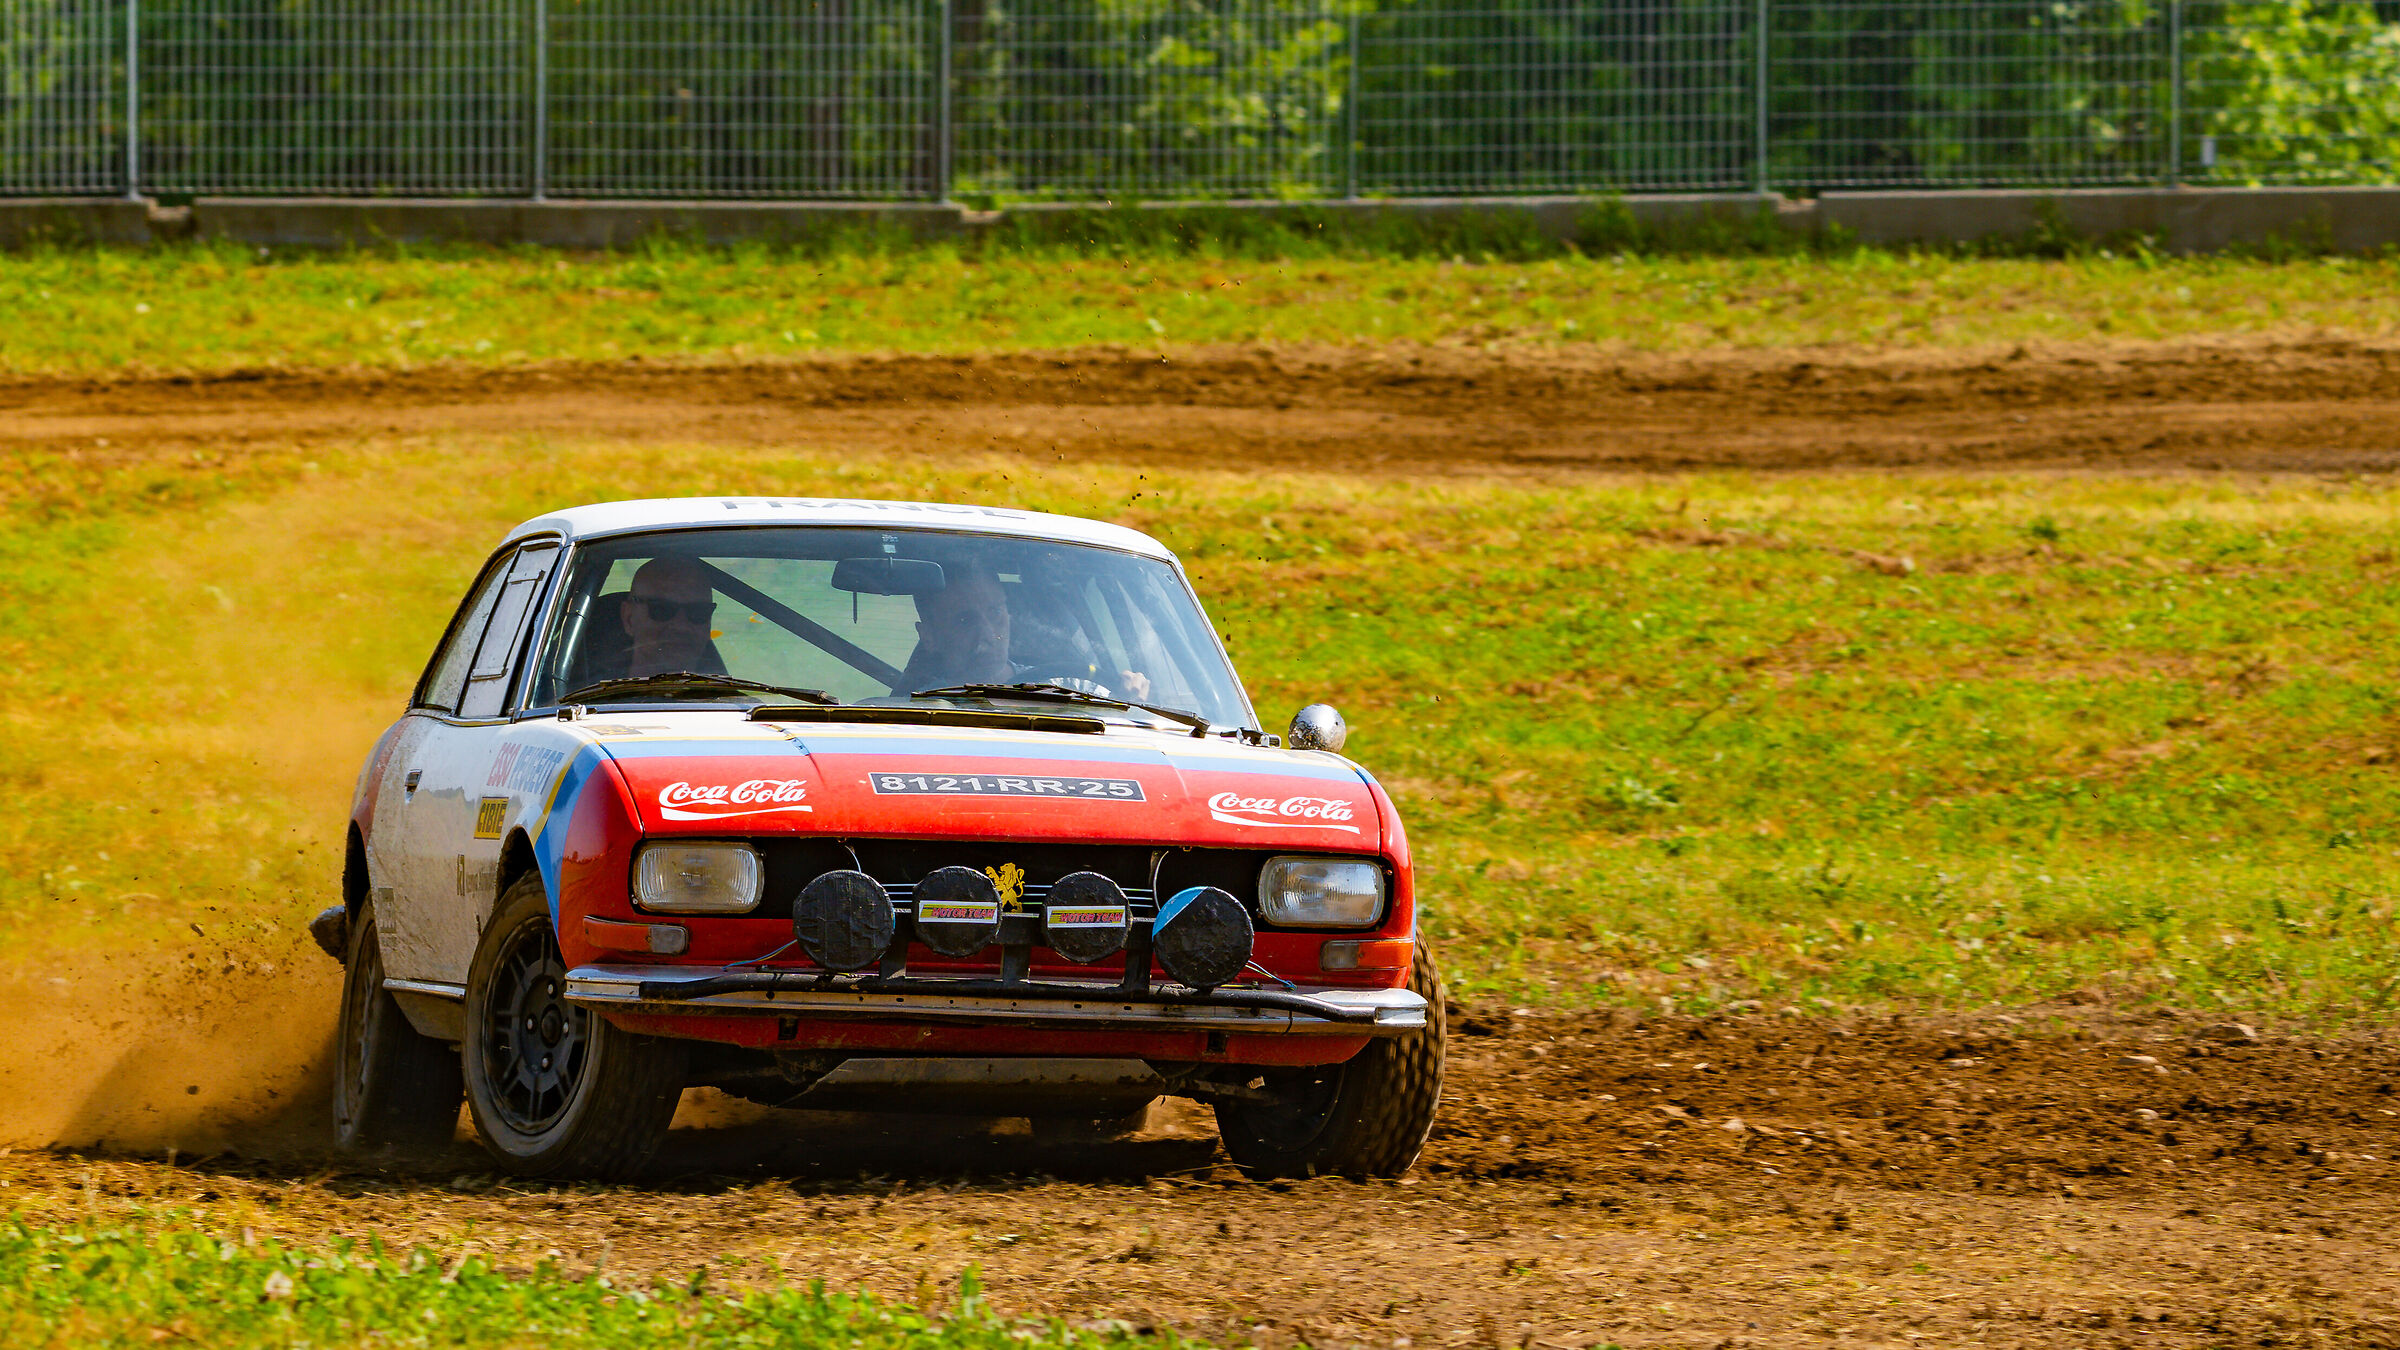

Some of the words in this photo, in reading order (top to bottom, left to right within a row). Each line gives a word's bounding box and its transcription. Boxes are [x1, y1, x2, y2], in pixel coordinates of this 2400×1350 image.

[486, 742, 521, 787] ESSO
[507, 745, 565, 795] PEUGEOT
[658, 781, 729, 807] Coca
[730, 779, 807, 804] Cola
[1208, 792, 1278, 816] Coca
[1278, 796, 1354, 821] Cola
[932, 908, 967, 918] MOTOR
[968, 908, 996, 918] TEAM
[1060, 913, 1096, 923] MOTOR
[1096, 913, 1124, 922] TEAM
